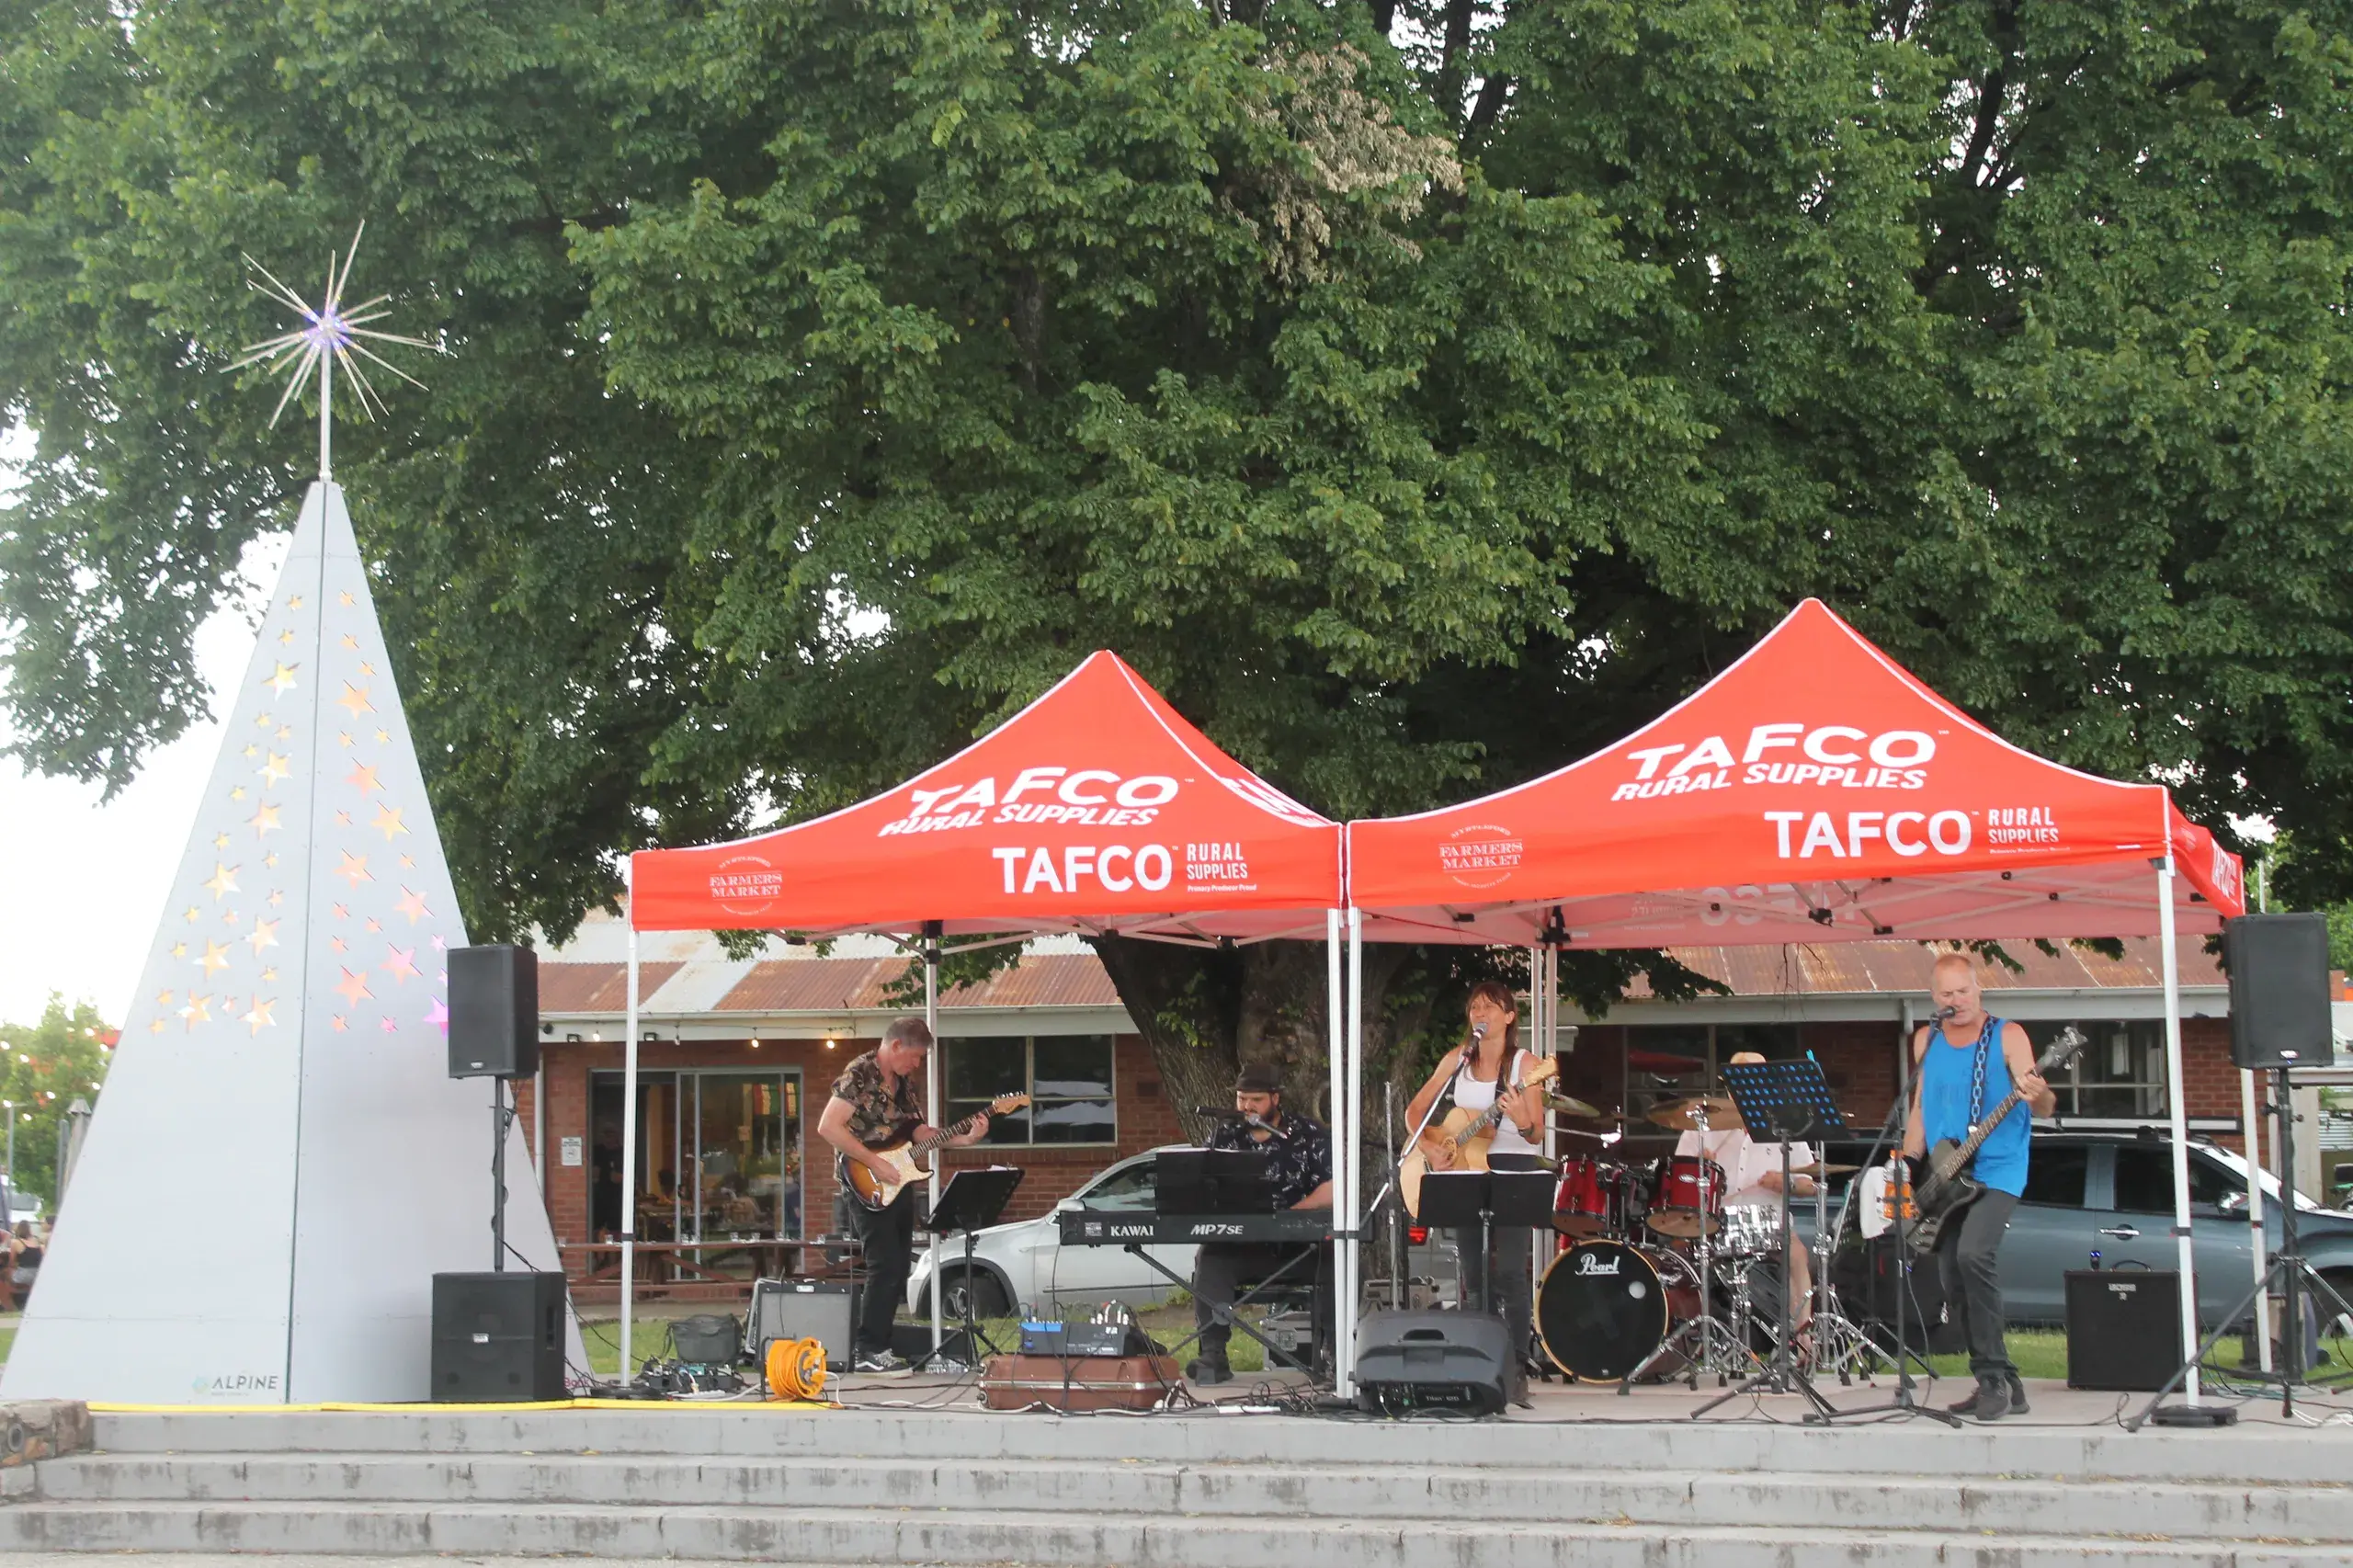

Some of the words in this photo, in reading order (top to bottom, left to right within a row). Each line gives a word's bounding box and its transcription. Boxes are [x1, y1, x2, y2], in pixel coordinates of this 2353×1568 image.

[1627, 723, 1936, 779] TAFCO
[1610, 770, 1732, 801] RURAL
[1742, 763, 1927, 789] SUPPLIES
[910, 767, 1179, 818] TAFCO
[877, 808, 986, 837] RURAL
[993, 803, 1159, 826] SUPPLIES
[1989, 807, 2054, 826] RURAL
[1764, 810, 1972, 858] TAFCO
[1988, 827, 2059, 844] SUPPLIES
[1187, 842, 1245, 861] RURAL
[1439, 842, 1523, 858] FARMERS
[992, 844, 1173, 893] TAFCO
[1187, 862, 1248, 880] SUPPLIES
[1442, 855, 1521, 869] MARKET
[710, 874, 782, 887] FARMERS
[1188, 884, 1211, 892] Primary
[1211, 883, 1238, 892] Producer
[1239, 883, 1256, 892] Proud
[711, 885, 781, 898] MARKET
[1110, 1224, 1154, 1236] KAWAI
[1190, 1223, 1244, 1235] MP7SE
[1574, 1253, 1620, 1276] Pearl
[211, 1375, 278, 1390] ALPINE
